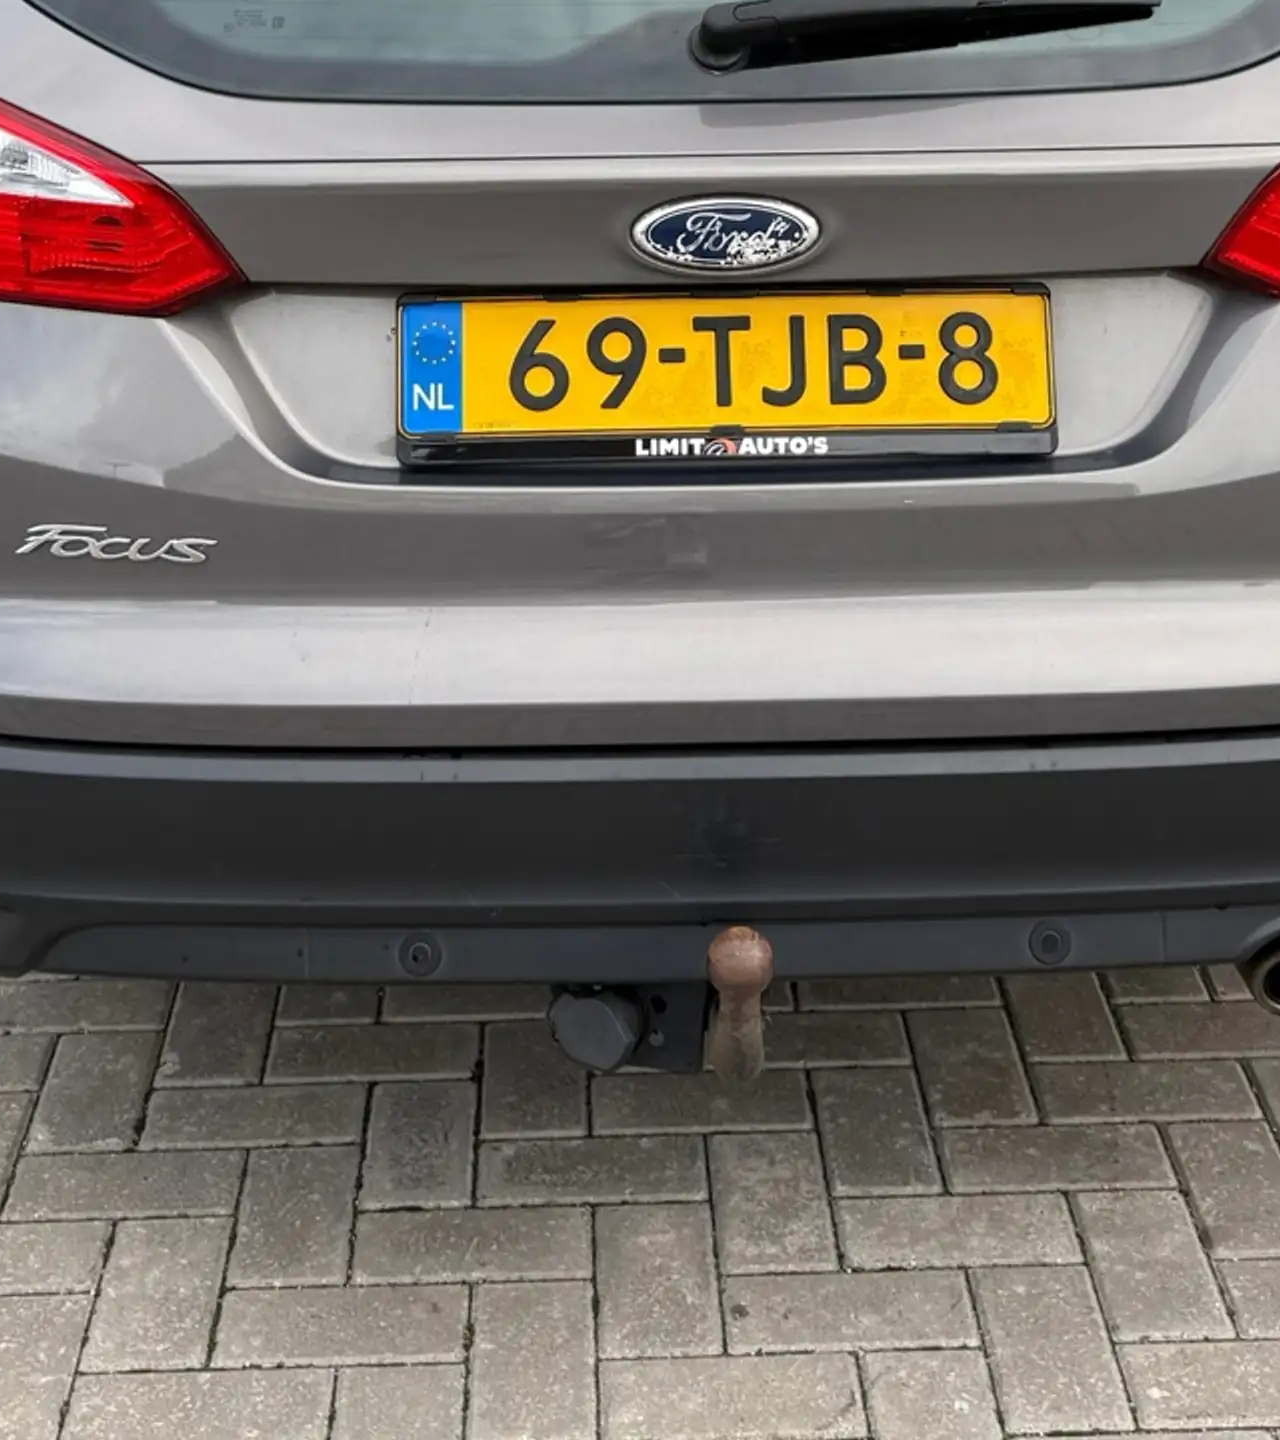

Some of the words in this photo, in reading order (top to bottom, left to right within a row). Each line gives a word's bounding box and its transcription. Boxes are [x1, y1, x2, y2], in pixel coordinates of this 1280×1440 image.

[676, 211, 790, 254] Ford
[509, 311, 1000, 413] 69-TJB-8
[412, 383, 454, 411] NL
[635, 437, 705, 456] LIMIT
[738, 436, 829, 455] AUTO'S
